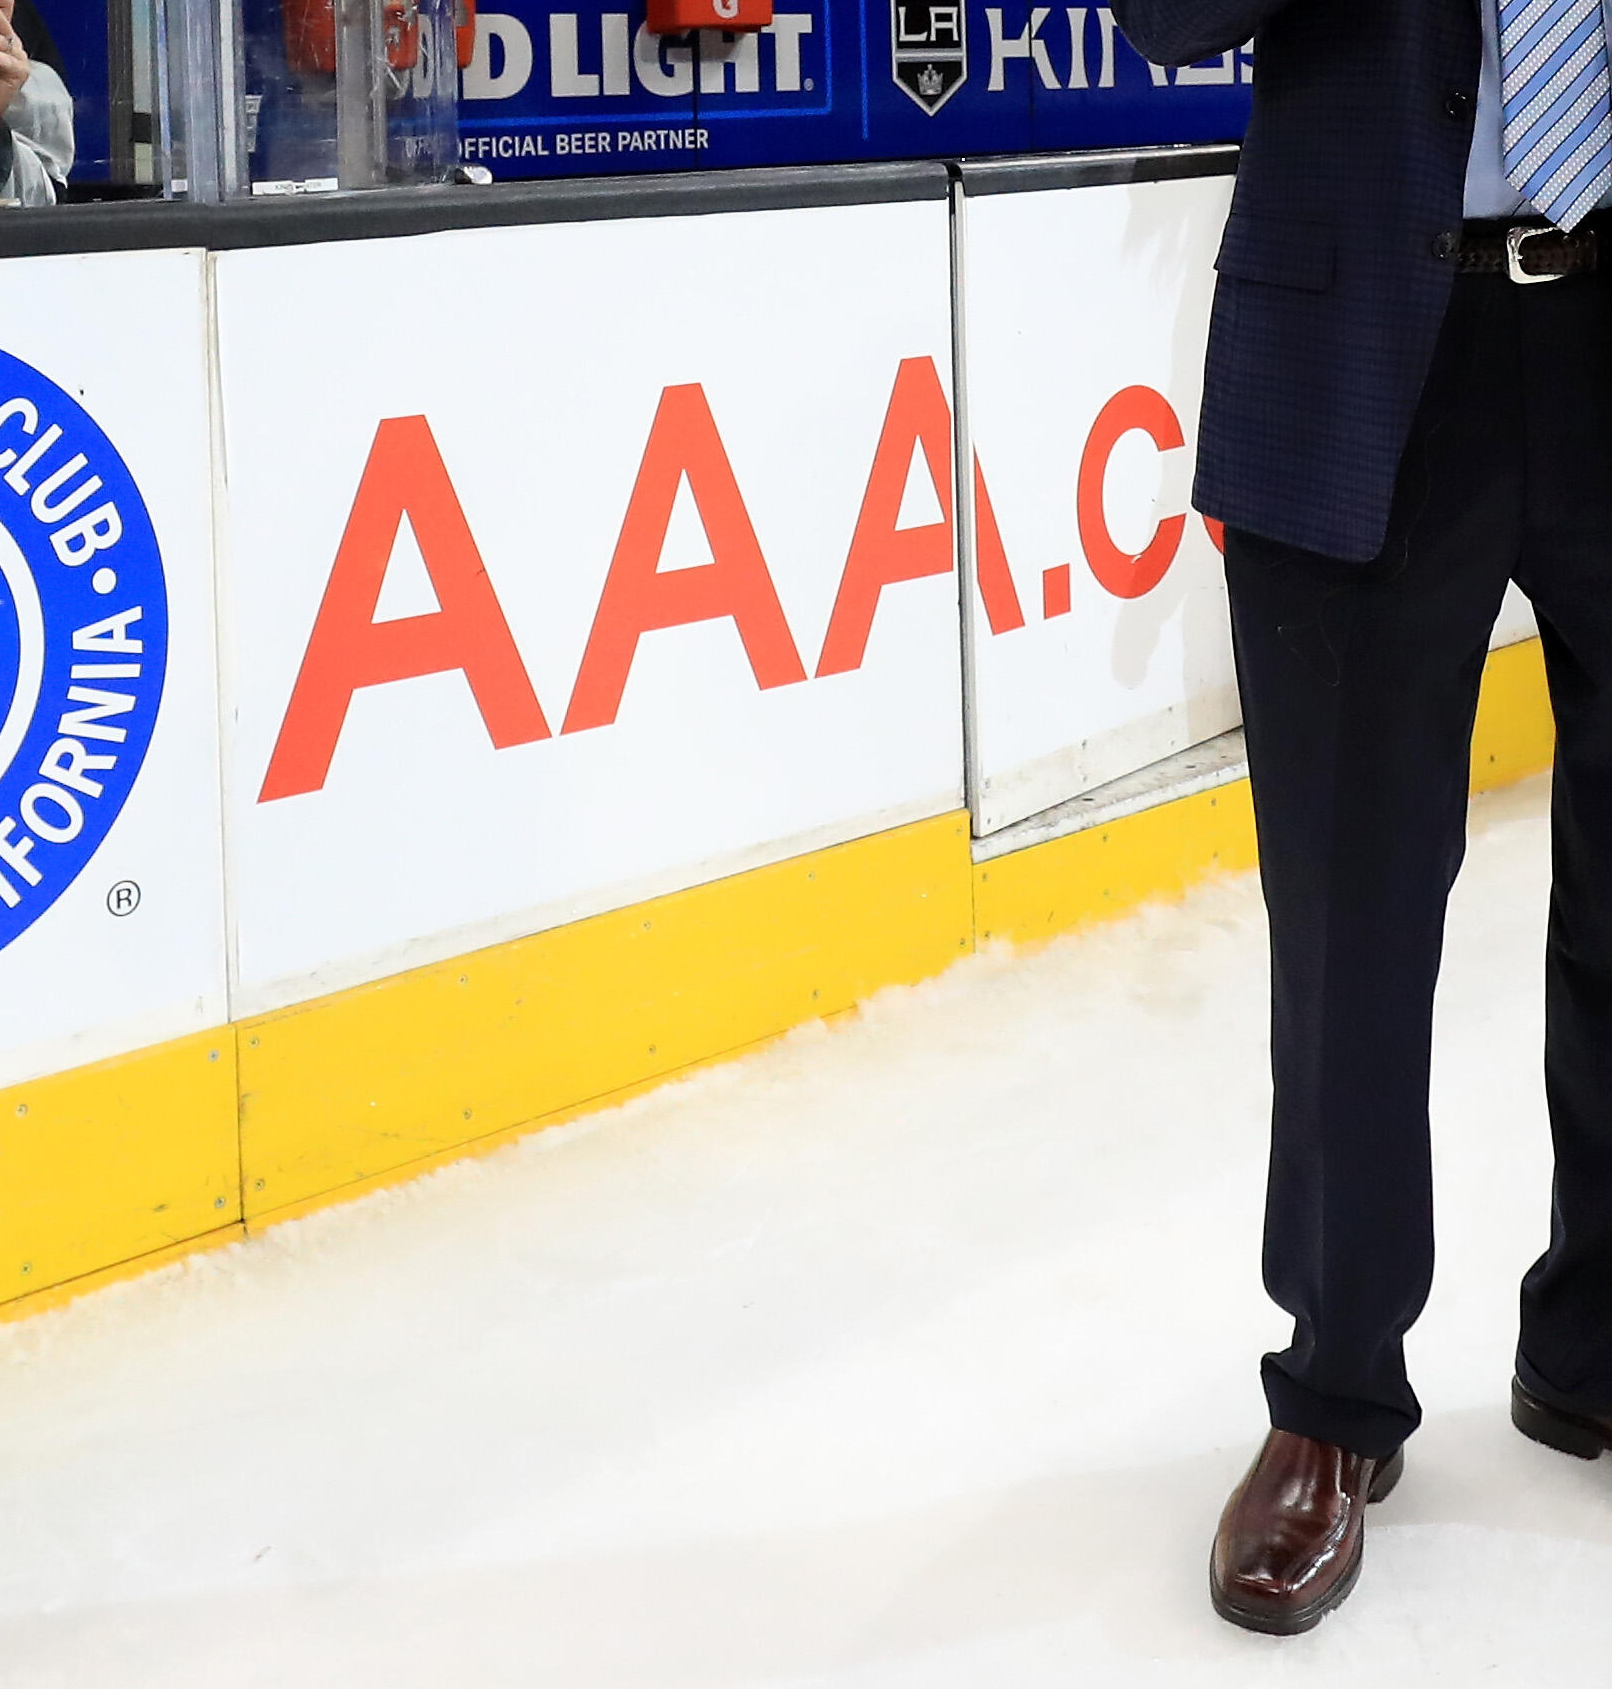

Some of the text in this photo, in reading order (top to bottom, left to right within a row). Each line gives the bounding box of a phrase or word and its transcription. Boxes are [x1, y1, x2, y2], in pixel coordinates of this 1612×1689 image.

[898, 6, 960, 42] LA
[549, 12, 813, 98] LIGHT
[555, 131, 611, 155] BEER
[617, 127, 710, 152] PARTNER
[255, 353, 1226, 804] AAA.c
